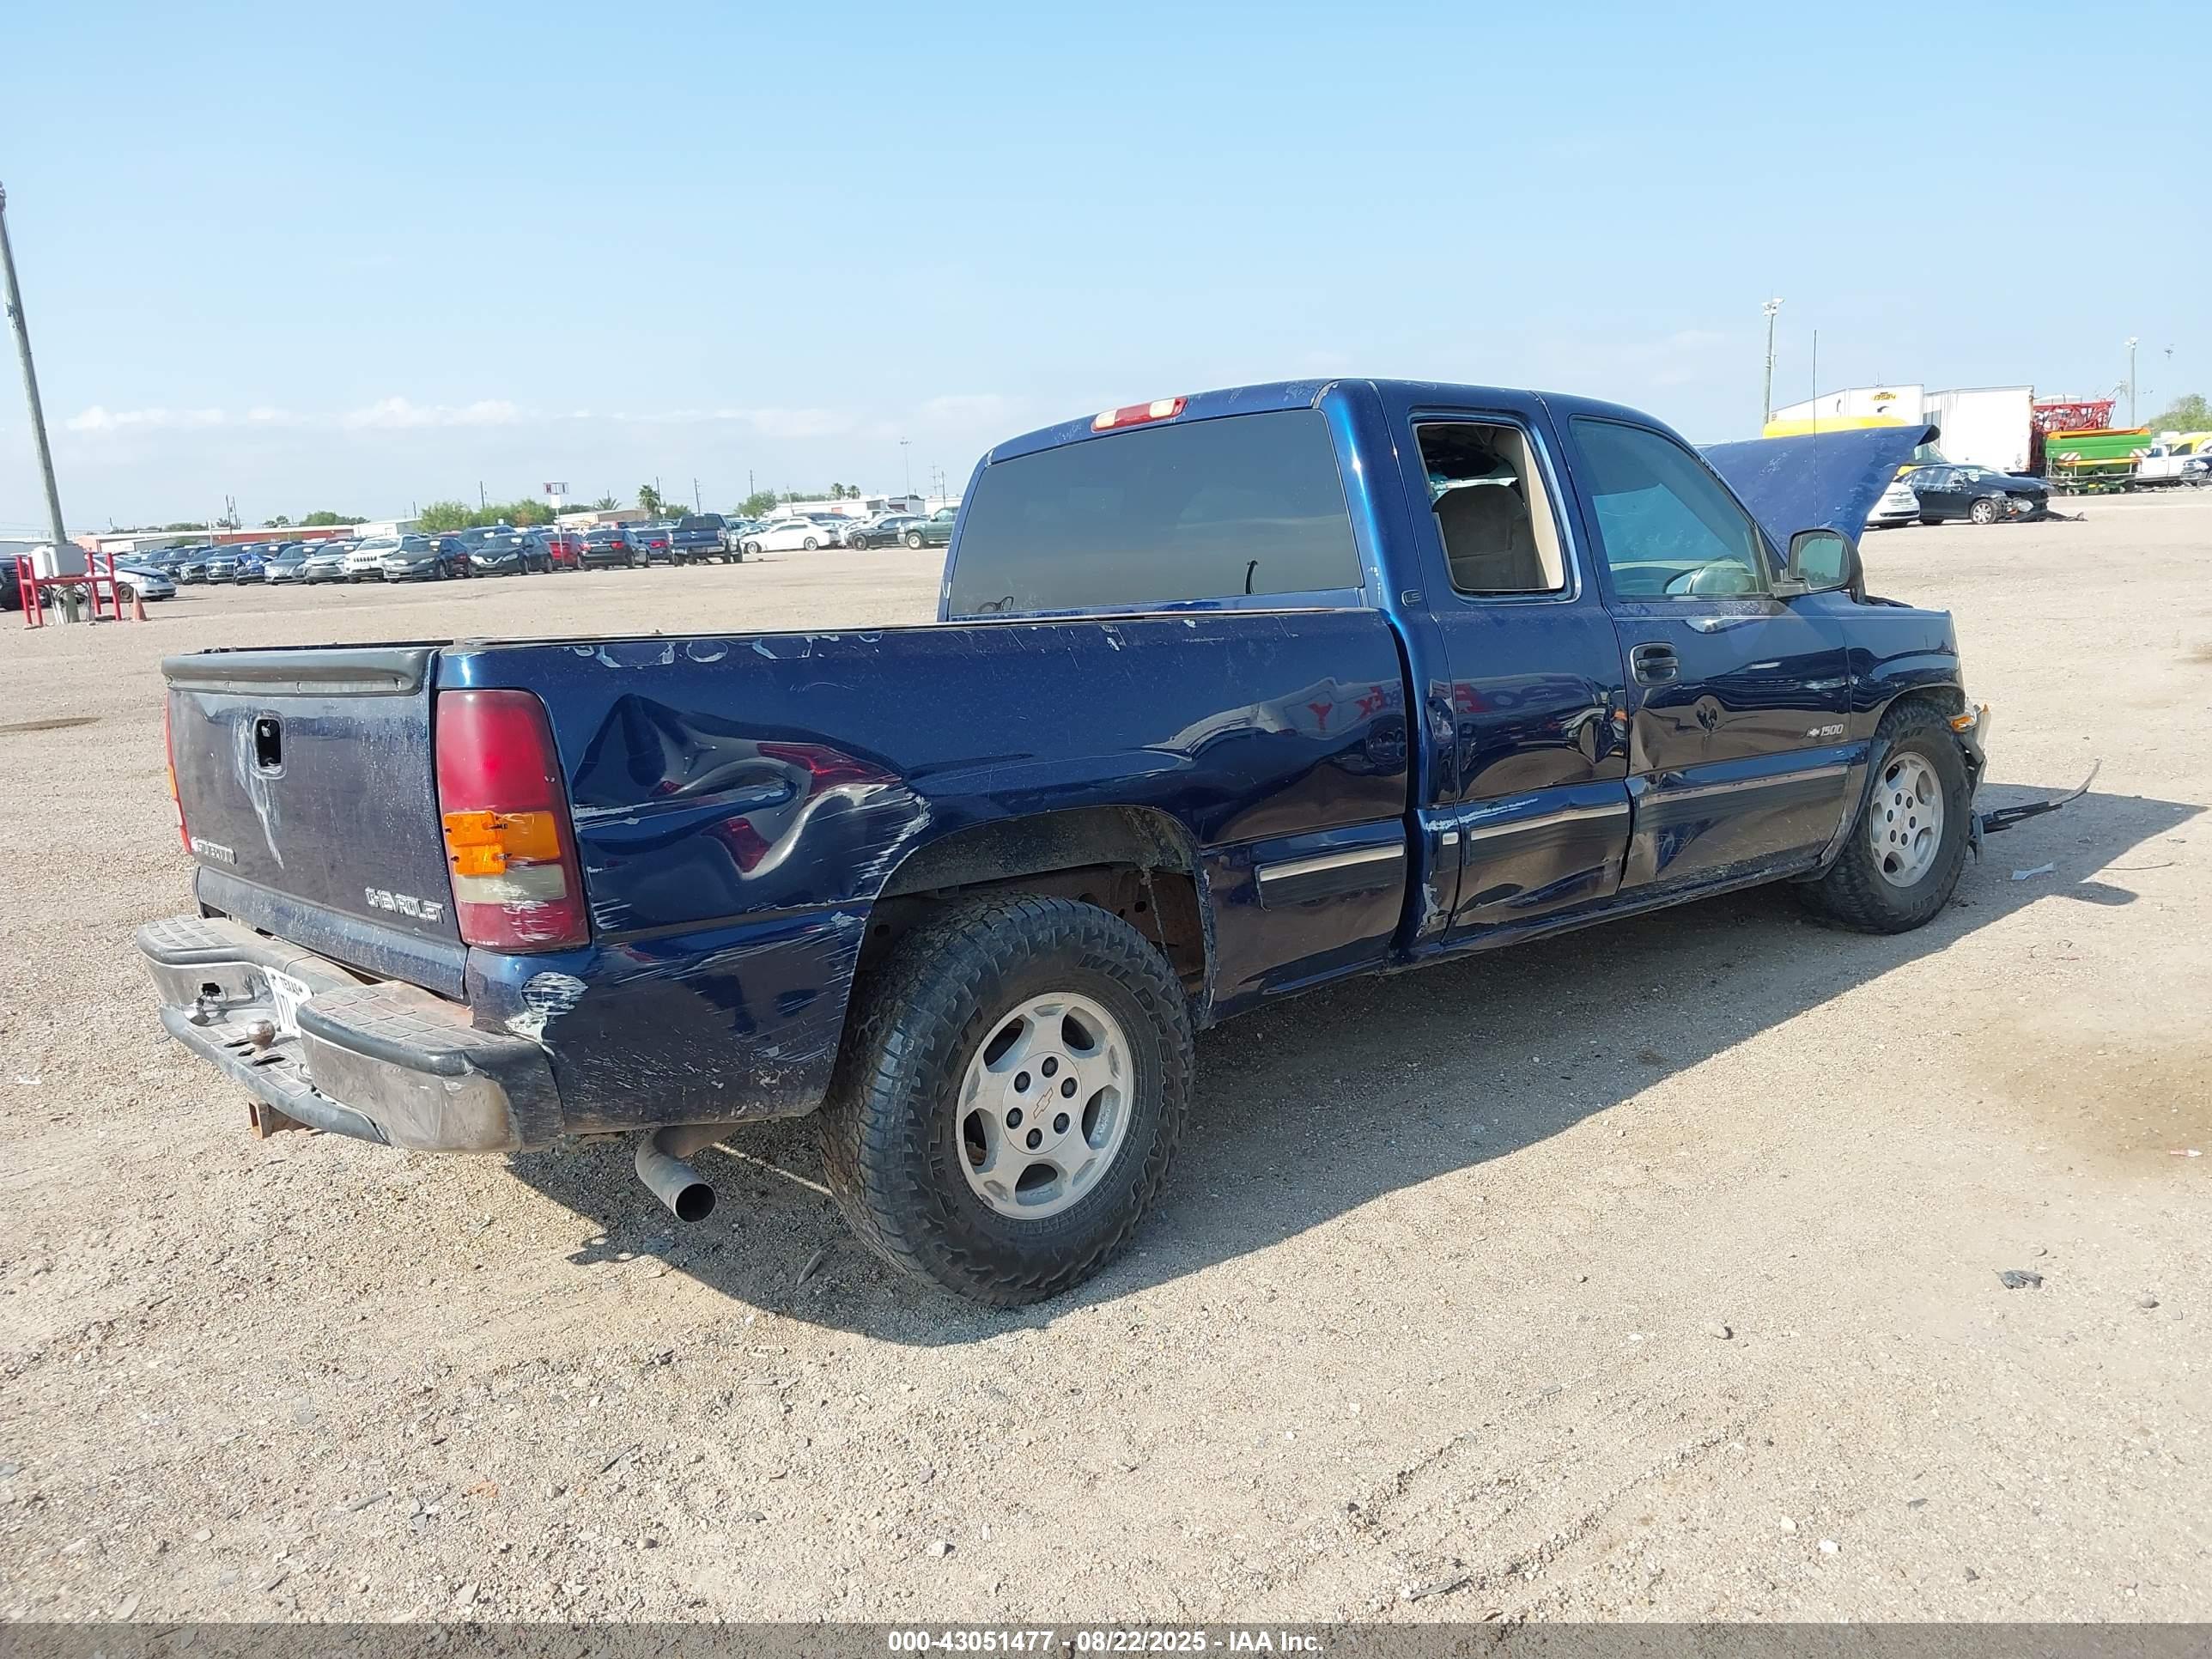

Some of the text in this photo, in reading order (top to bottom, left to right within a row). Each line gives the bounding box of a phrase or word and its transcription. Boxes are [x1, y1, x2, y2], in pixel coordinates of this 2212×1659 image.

[1820, 724, 1844, 736] 1500
[364, 886, 443, 924] CHEVROLET
[279, 975, 301, 997] TEXAS
